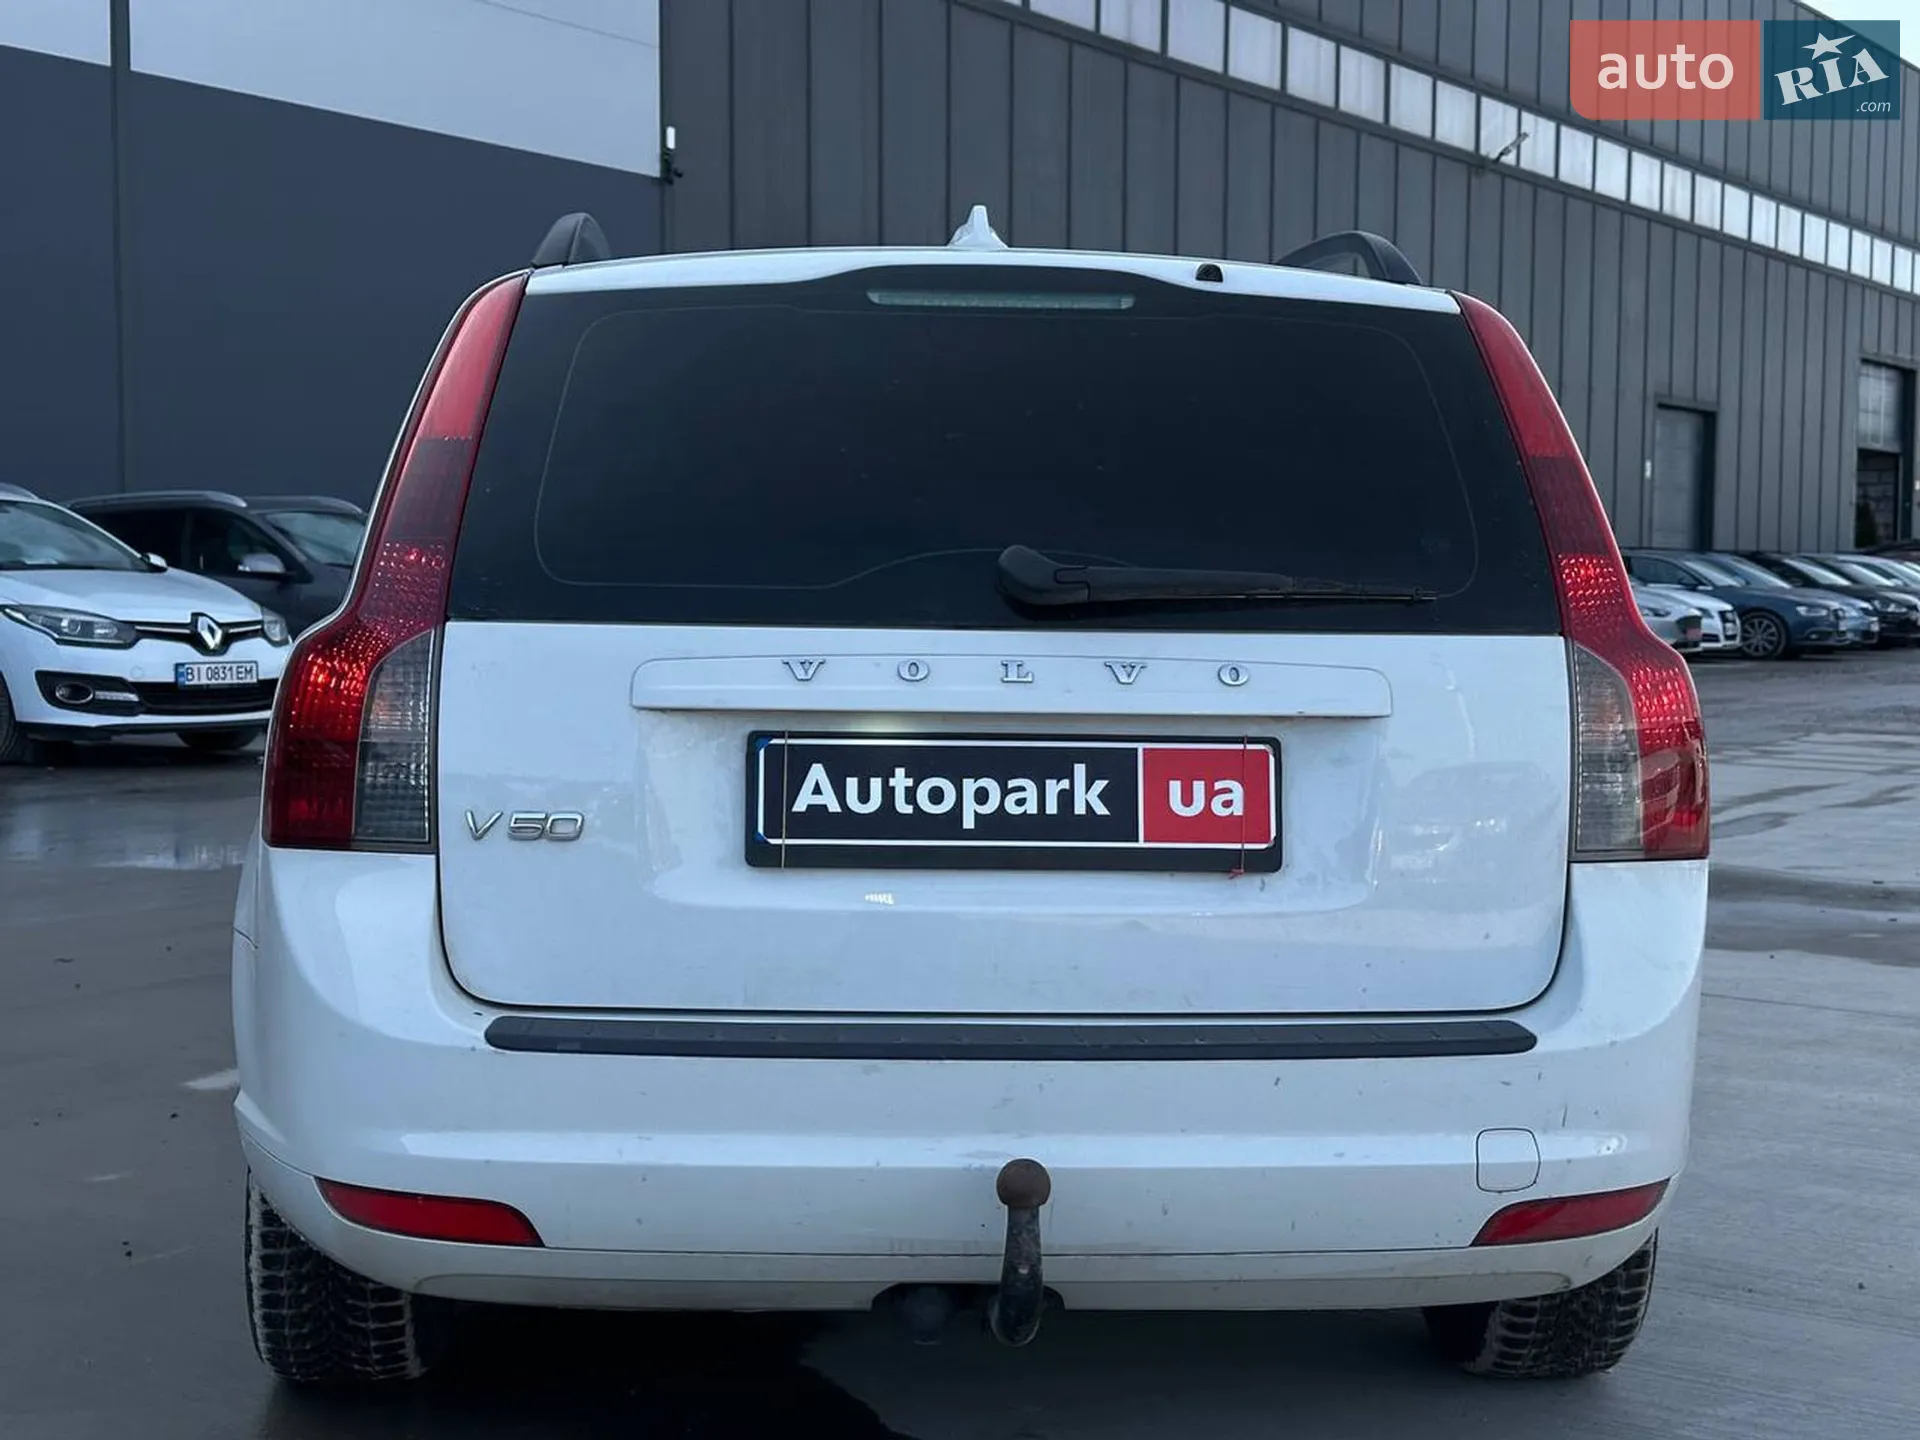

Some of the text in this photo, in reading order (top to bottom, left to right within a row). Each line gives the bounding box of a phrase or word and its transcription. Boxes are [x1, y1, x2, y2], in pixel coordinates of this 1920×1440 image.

[185, 667, 201, 682] BI
[783, 658, 1249, 688] VOLVO
[791, 763, 1245, 830] Autopark ua
